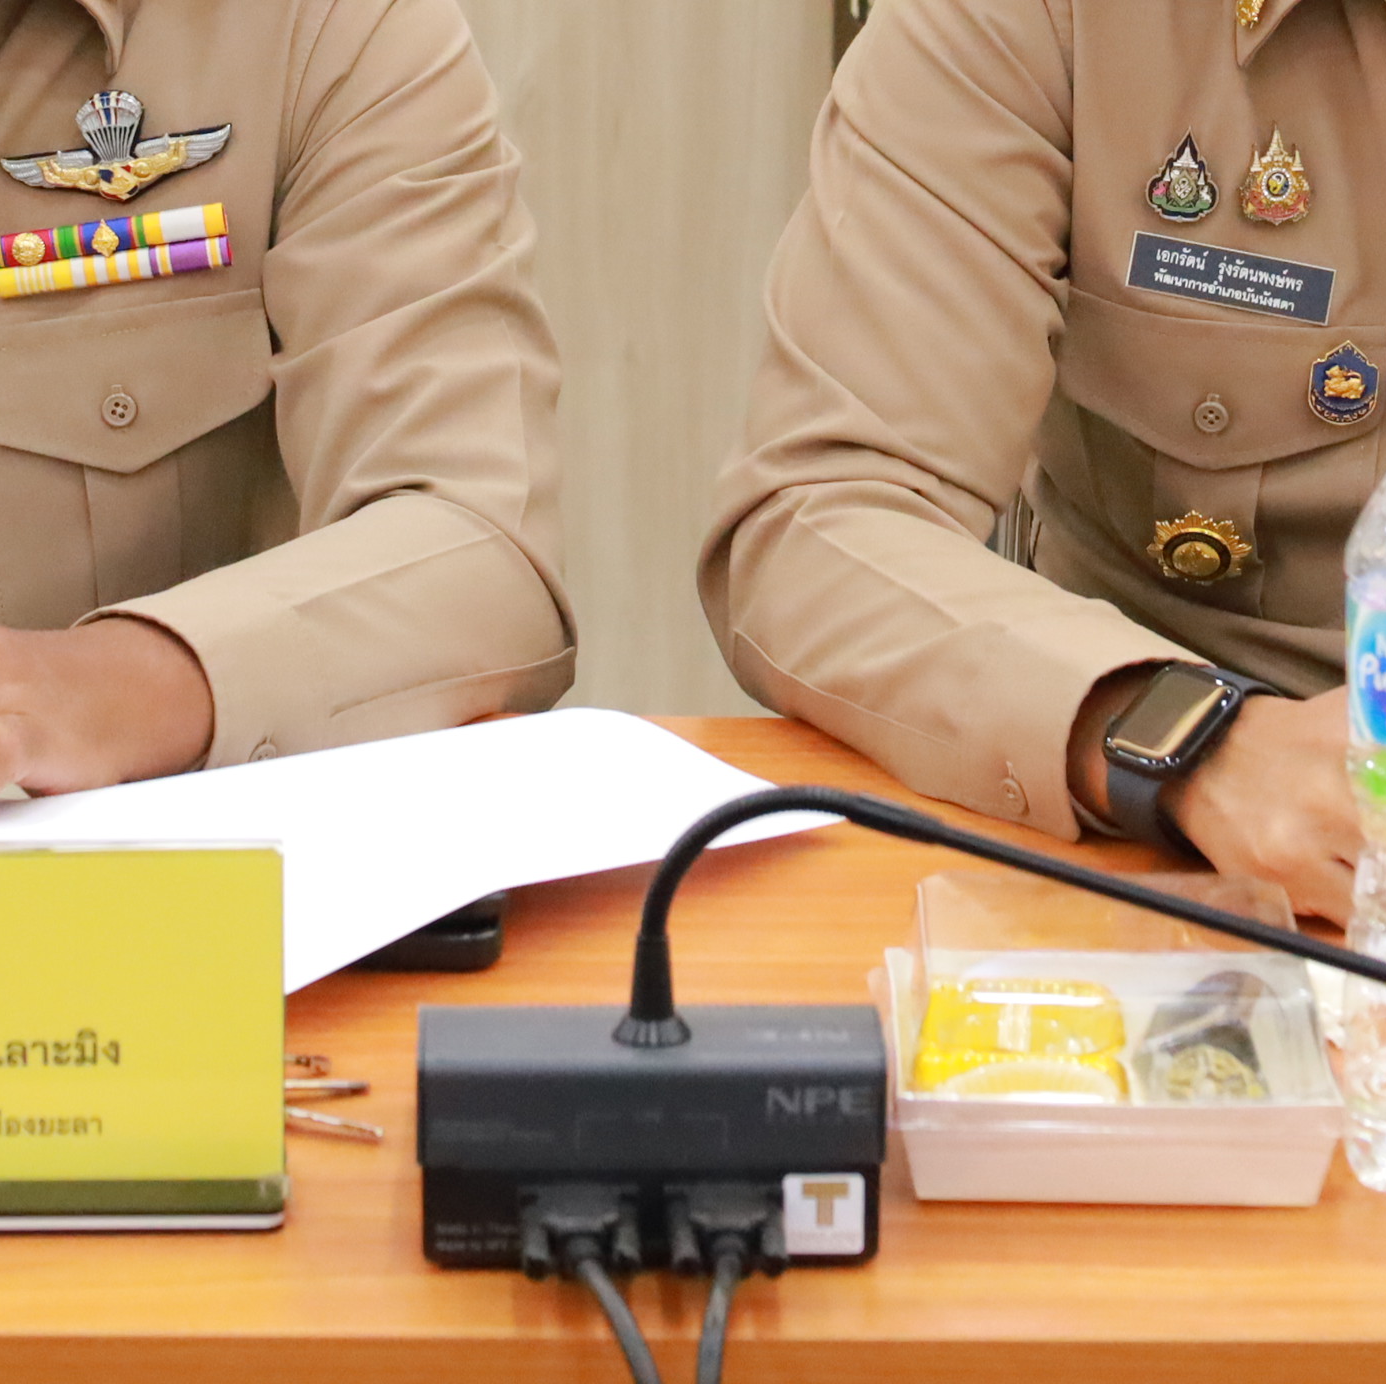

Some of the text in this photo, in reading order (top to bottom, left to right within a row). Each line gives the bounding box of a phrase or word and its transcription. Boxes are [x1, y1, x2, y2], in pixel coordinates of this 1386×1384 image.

[1153, 268, 1295, 312] พัฒนาการอำเภอบันนังสตา
[1155, 247, 1304, 292] เอกรัตน์ รุ่งรัตนพงษ์พร
[802, 1182, 849, 1226] T
